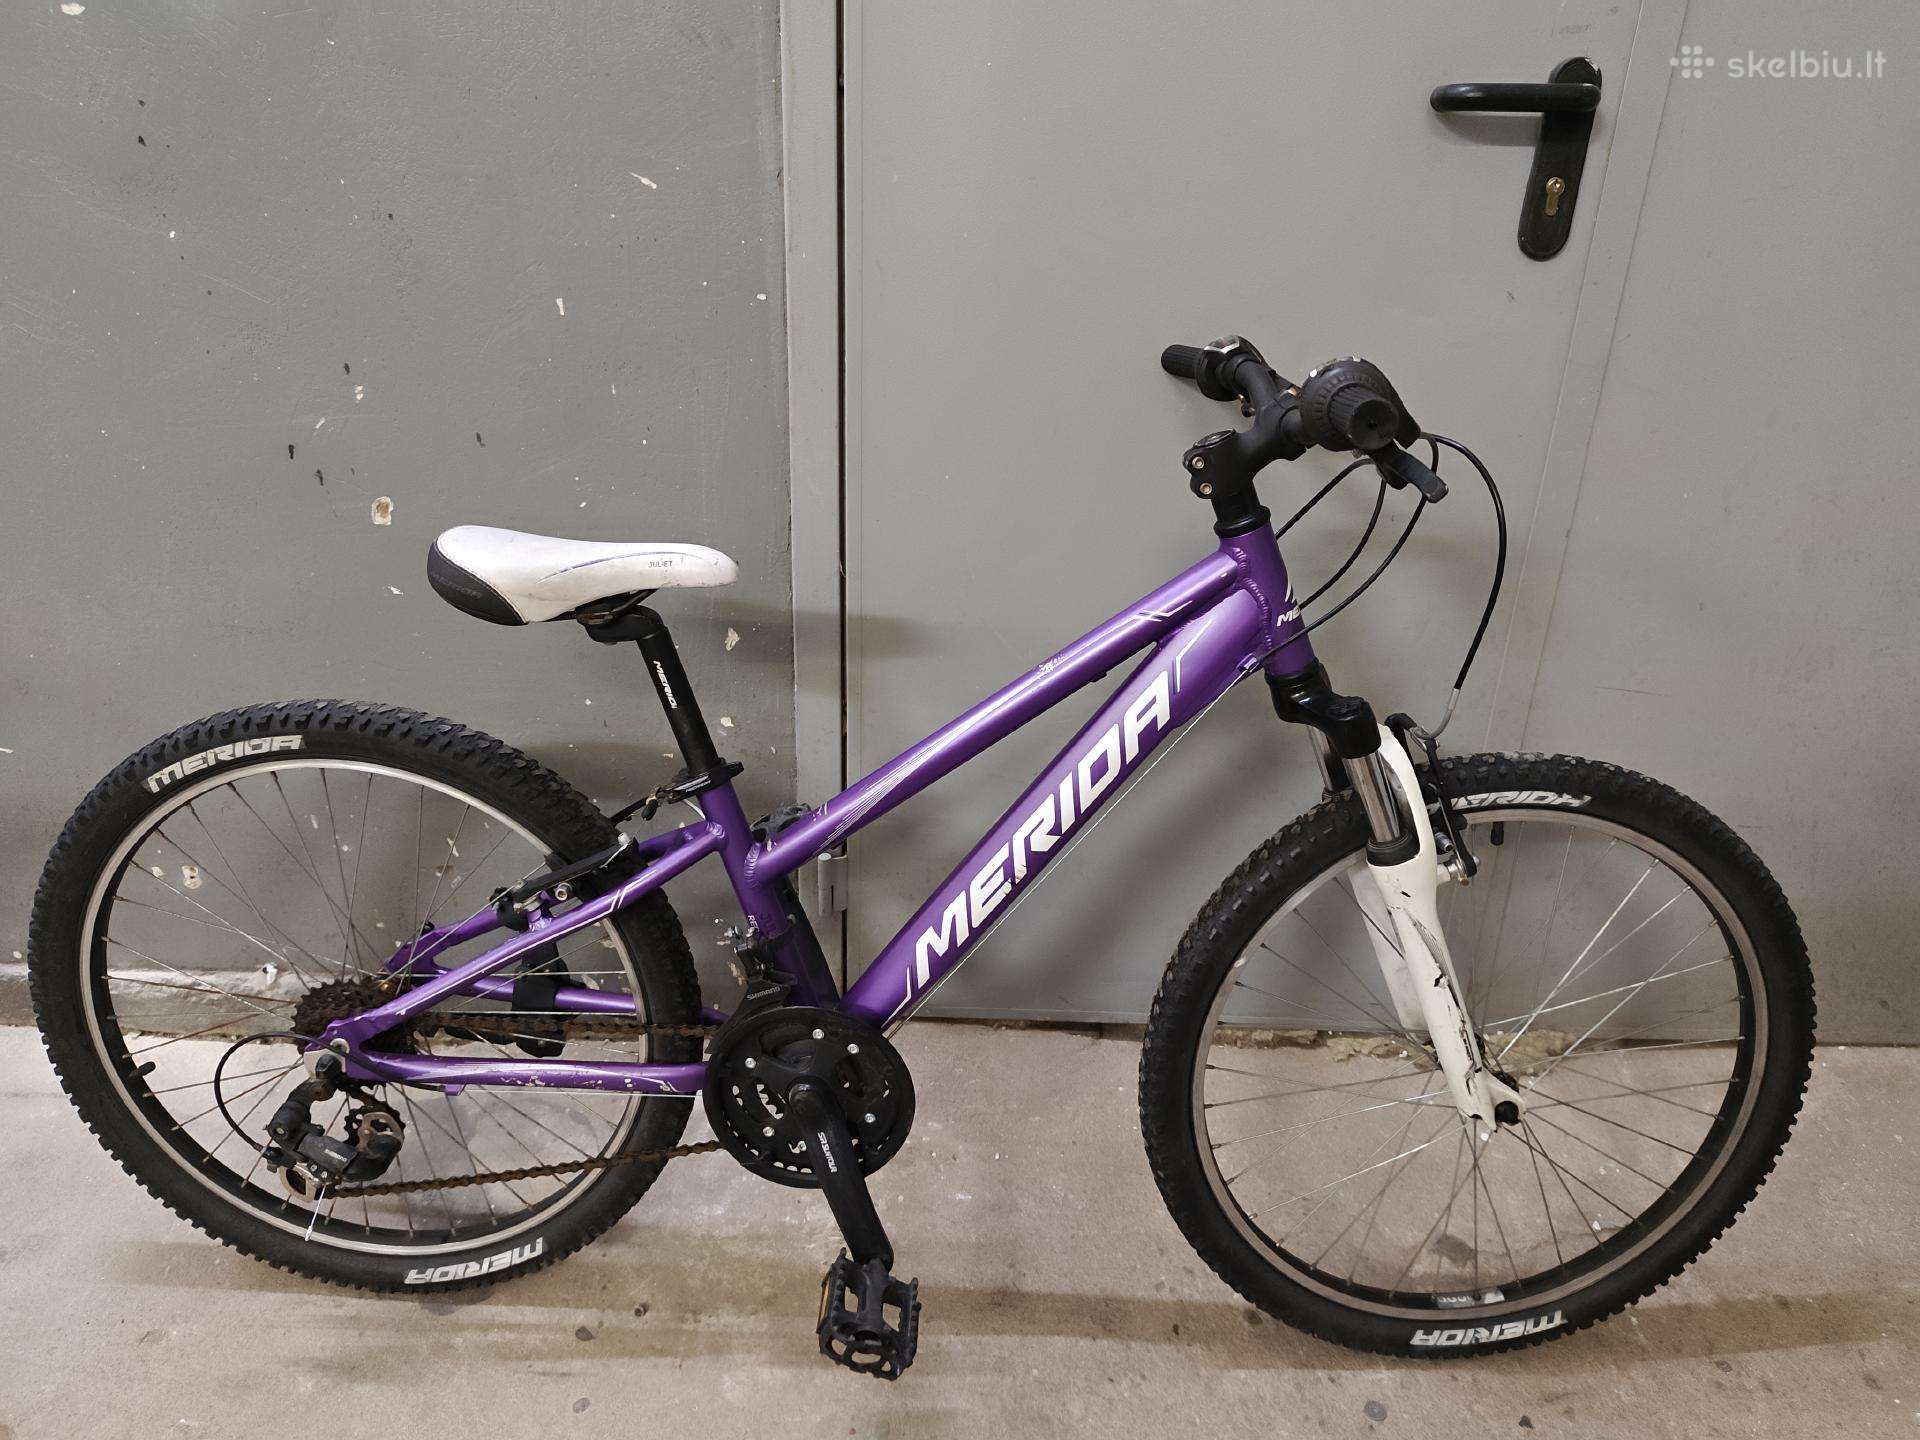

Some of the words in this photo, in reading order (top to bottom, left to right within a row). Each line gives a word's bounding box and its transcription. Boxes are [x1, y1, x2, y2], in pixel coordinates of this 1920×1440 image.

[147, 735, 303, 794] MERIDA
[915, 670, 1171, 989] MERIDA
[404, 1236, 544, 1284] MERIDA
[1409, 1310, 1568, 1346] MERIDA
